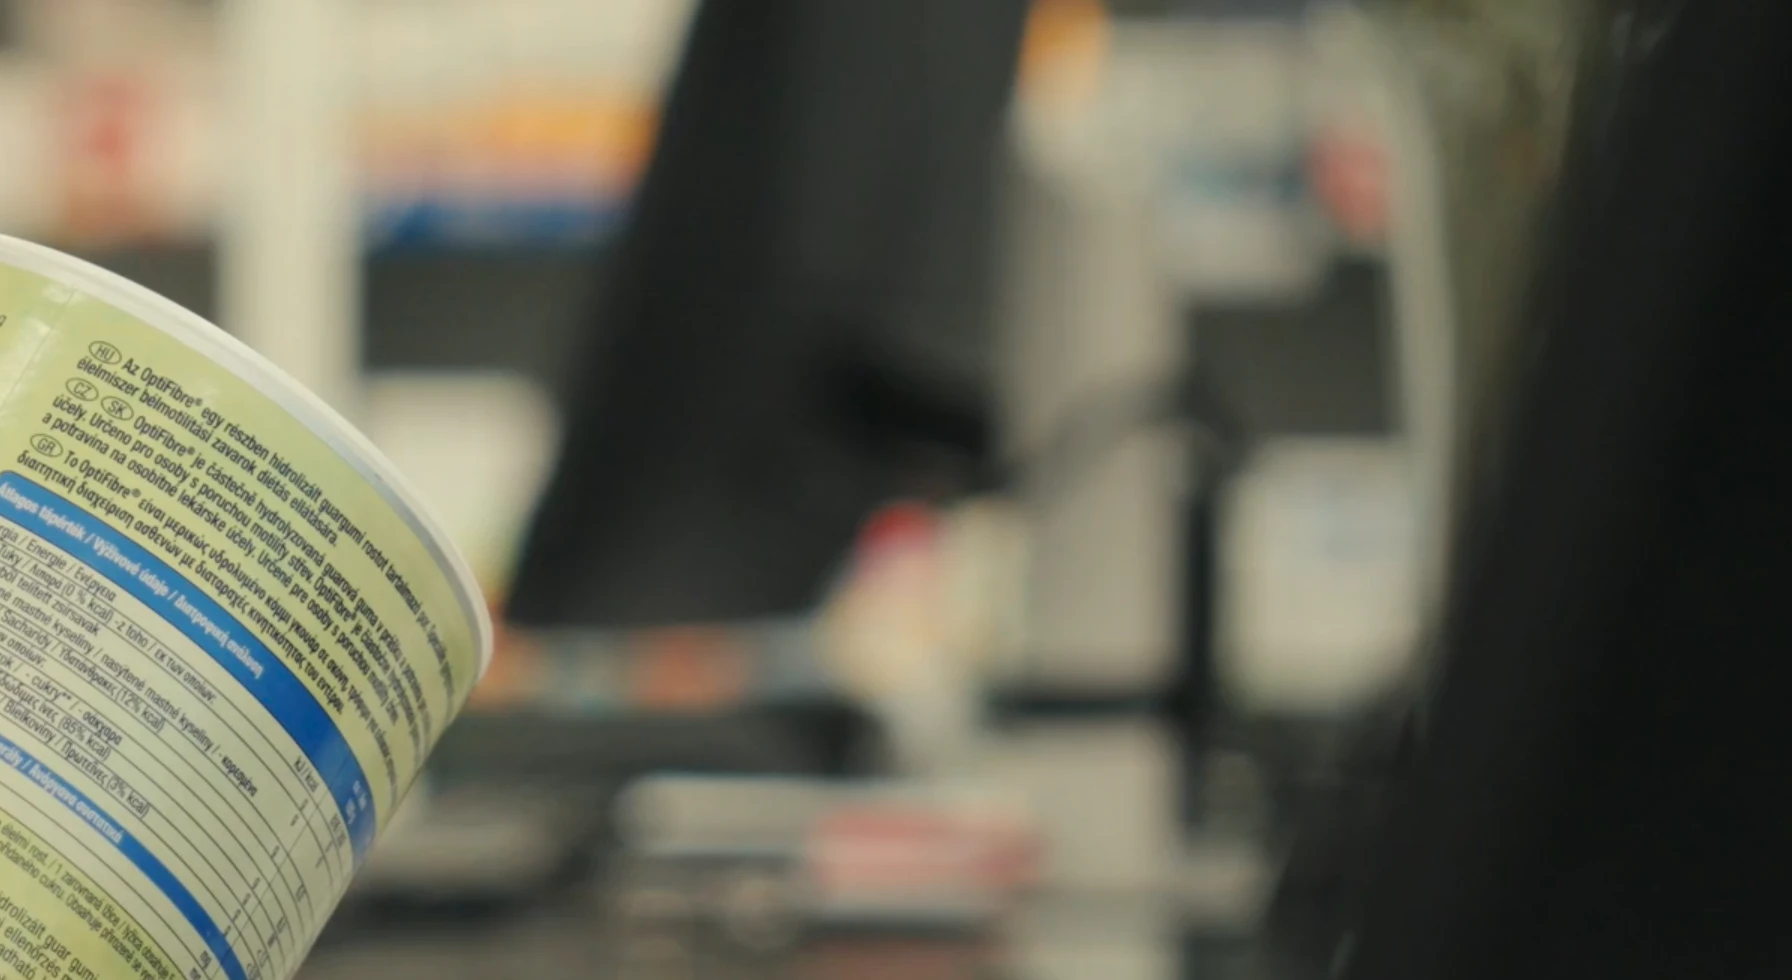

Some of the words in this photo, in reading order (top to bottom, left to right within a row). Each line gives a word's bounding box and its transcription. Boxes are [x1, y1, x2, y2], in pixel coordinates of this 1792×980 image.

[51, 394, 87, 421] účely.
[88, 411, 132, 445] Určeno
[129, 438, 154, 459] pro
[153, 452, 191, 485] osoby
[196, 482, 251, 528] poruchou
[249, 521, 289, 562] motility
[76, 357, 140, 396] élelmiszer
[210, 437, 257, 475] zavarok
[255, 469, 291, 502] diétás
[120, 357, 140, 376] Az
[200, 406, 225, 430] egy
[223, 421, 269, 460] részben
[268, 452, 322, 503] hidrolizált
[25, 537, 67, 570] Energie
[49, 417, 110, 455] potravina
[108, 447, 127, 465] na
[126, 458, 178, 497] osobitné
[177, 488, 226, 532] lekárske
[224, 526, 256, 558] účely.
[256, 549, 293, 588] Určené
[287, 582, 309, 604] pre
[177, 552, 196, 569] με
[188, 452, 206, 470] je
[204, 461, 257, 506] částečně
[254, 499, 325, 567] hydrolyzovaná
[320, 562, 358, 602] guarová
[353, 596, 379, 627] guma
[11, 595, 53, 626] mastné
[51, 618, 95, 656] kyseliny
[99, 653, 145, 691] nasýtené
[144, 686, 180, 720] mastné
[124, 623, 149, 648] toho
[41, 933, 72, 961] guar
